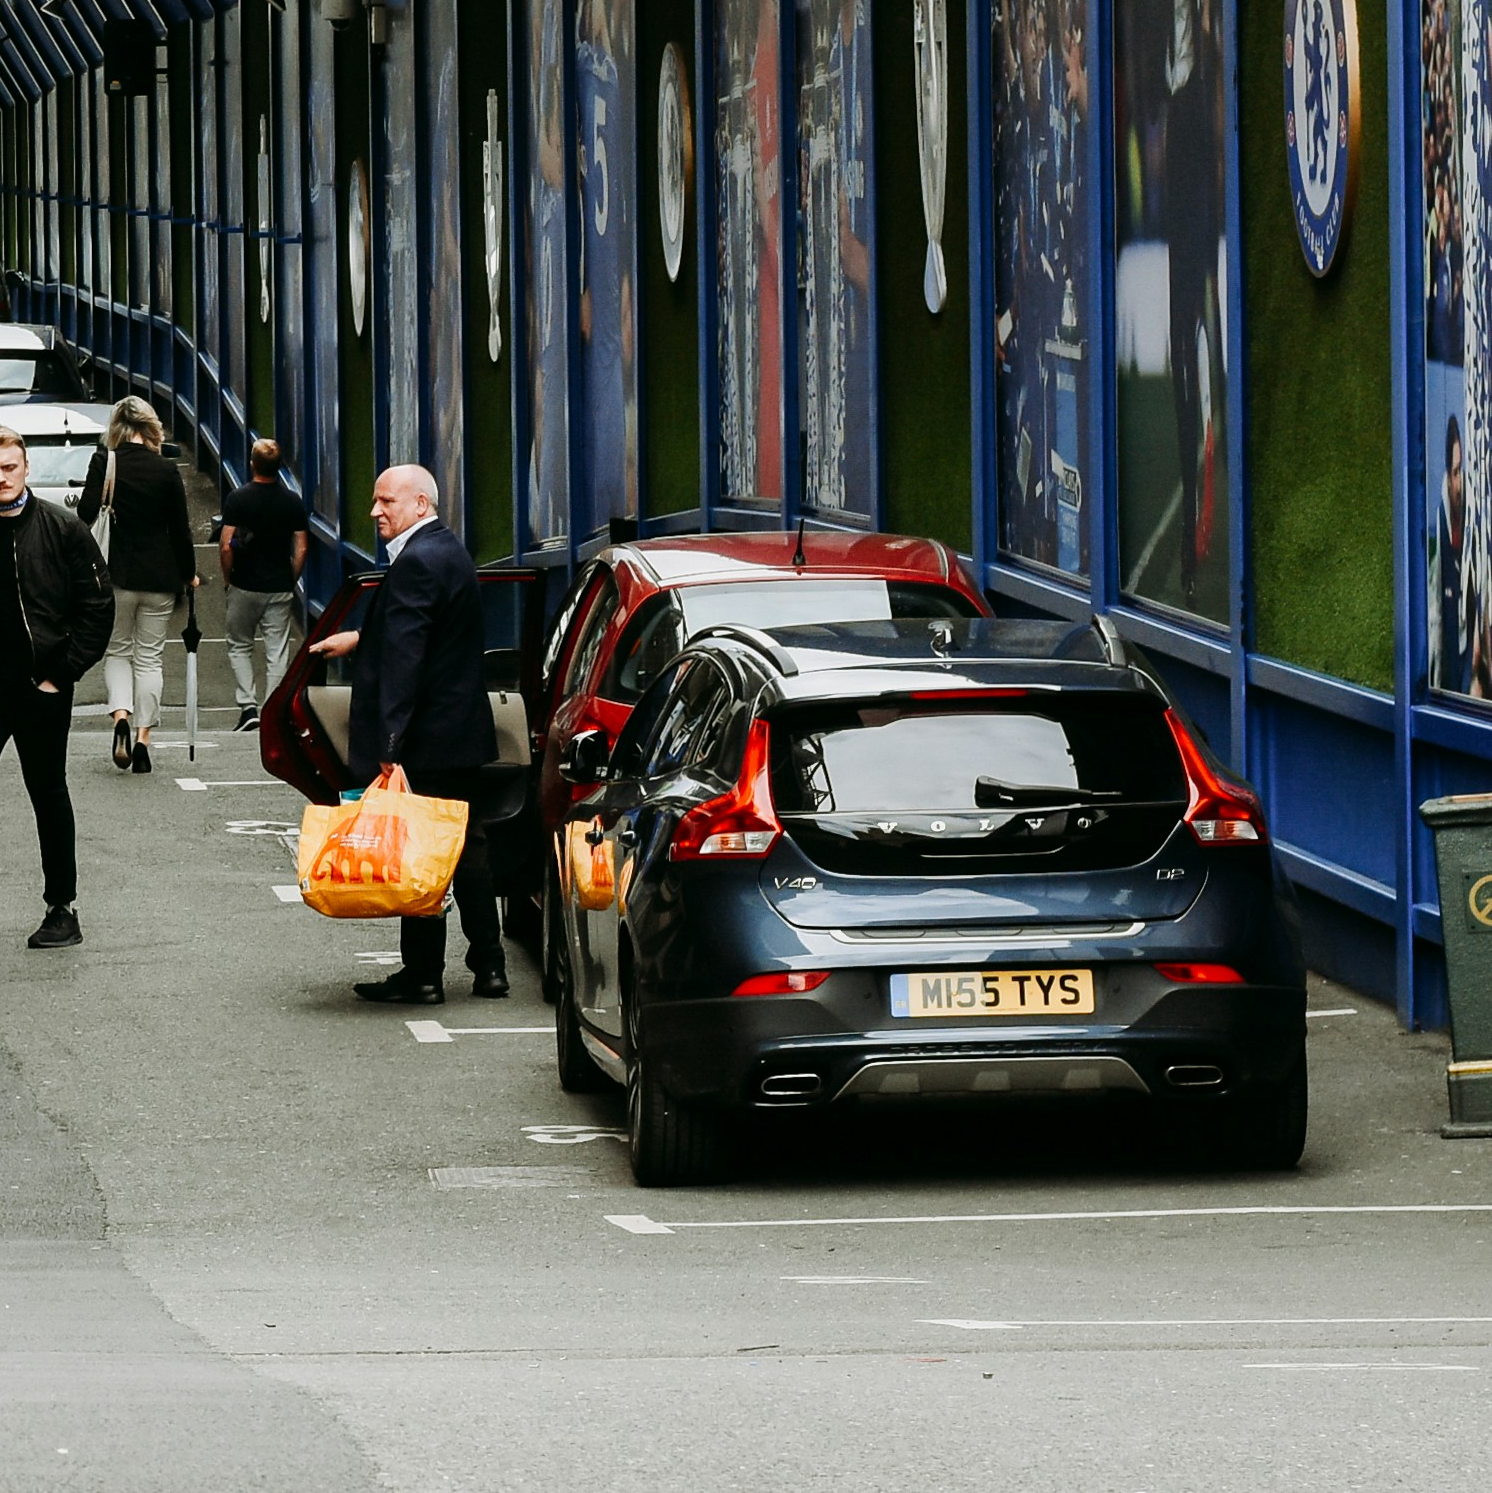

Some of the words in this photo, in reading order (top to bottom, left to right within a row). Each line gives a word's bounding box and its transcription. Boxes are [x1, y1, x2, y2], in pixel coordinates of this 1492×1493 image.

[877, 815, 1092, 835] VOLVO
[1156, 867, 1186, 881] D2
[774, 876, 819, 890] V40
[1012, 974, 1080, 1006] TYS
